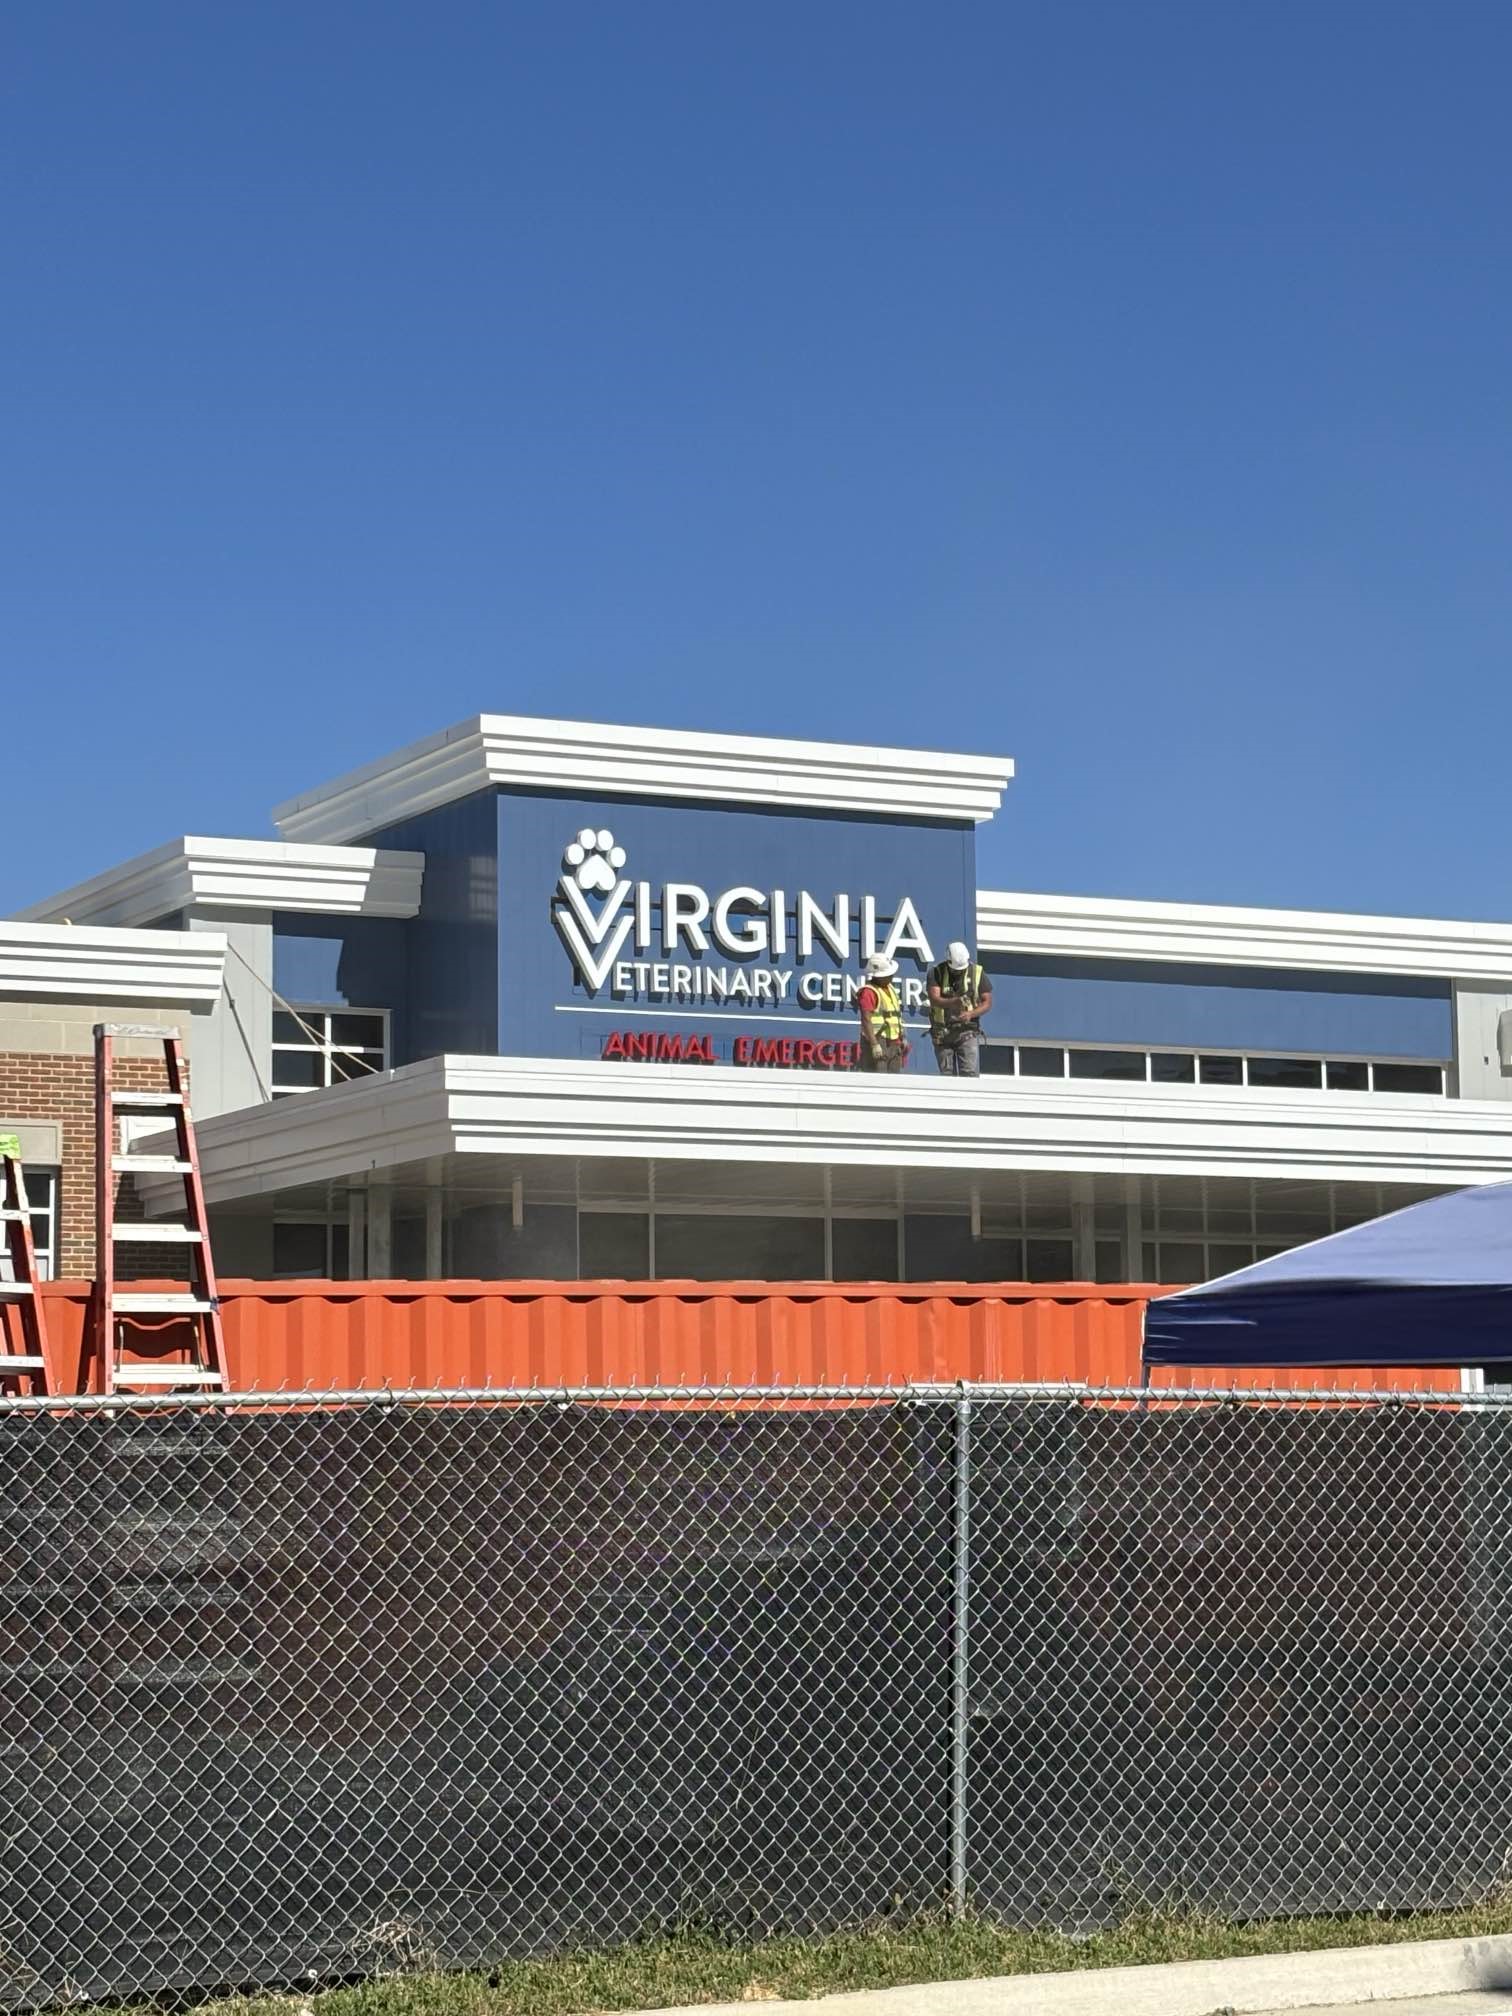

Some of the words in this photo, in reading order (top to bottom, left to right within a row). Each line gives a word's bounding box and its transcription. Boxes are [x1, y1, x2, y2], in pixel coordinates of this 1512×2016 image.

[555, 910, 793, 999] VETERINARY
[799, 971, 931, 1008] CENR
[559, 875, 935, 962] VIRGINIA
[603, 1031, 718, 1062] ANIMAL
[738, 1036, 913, 1069] EMERGE
